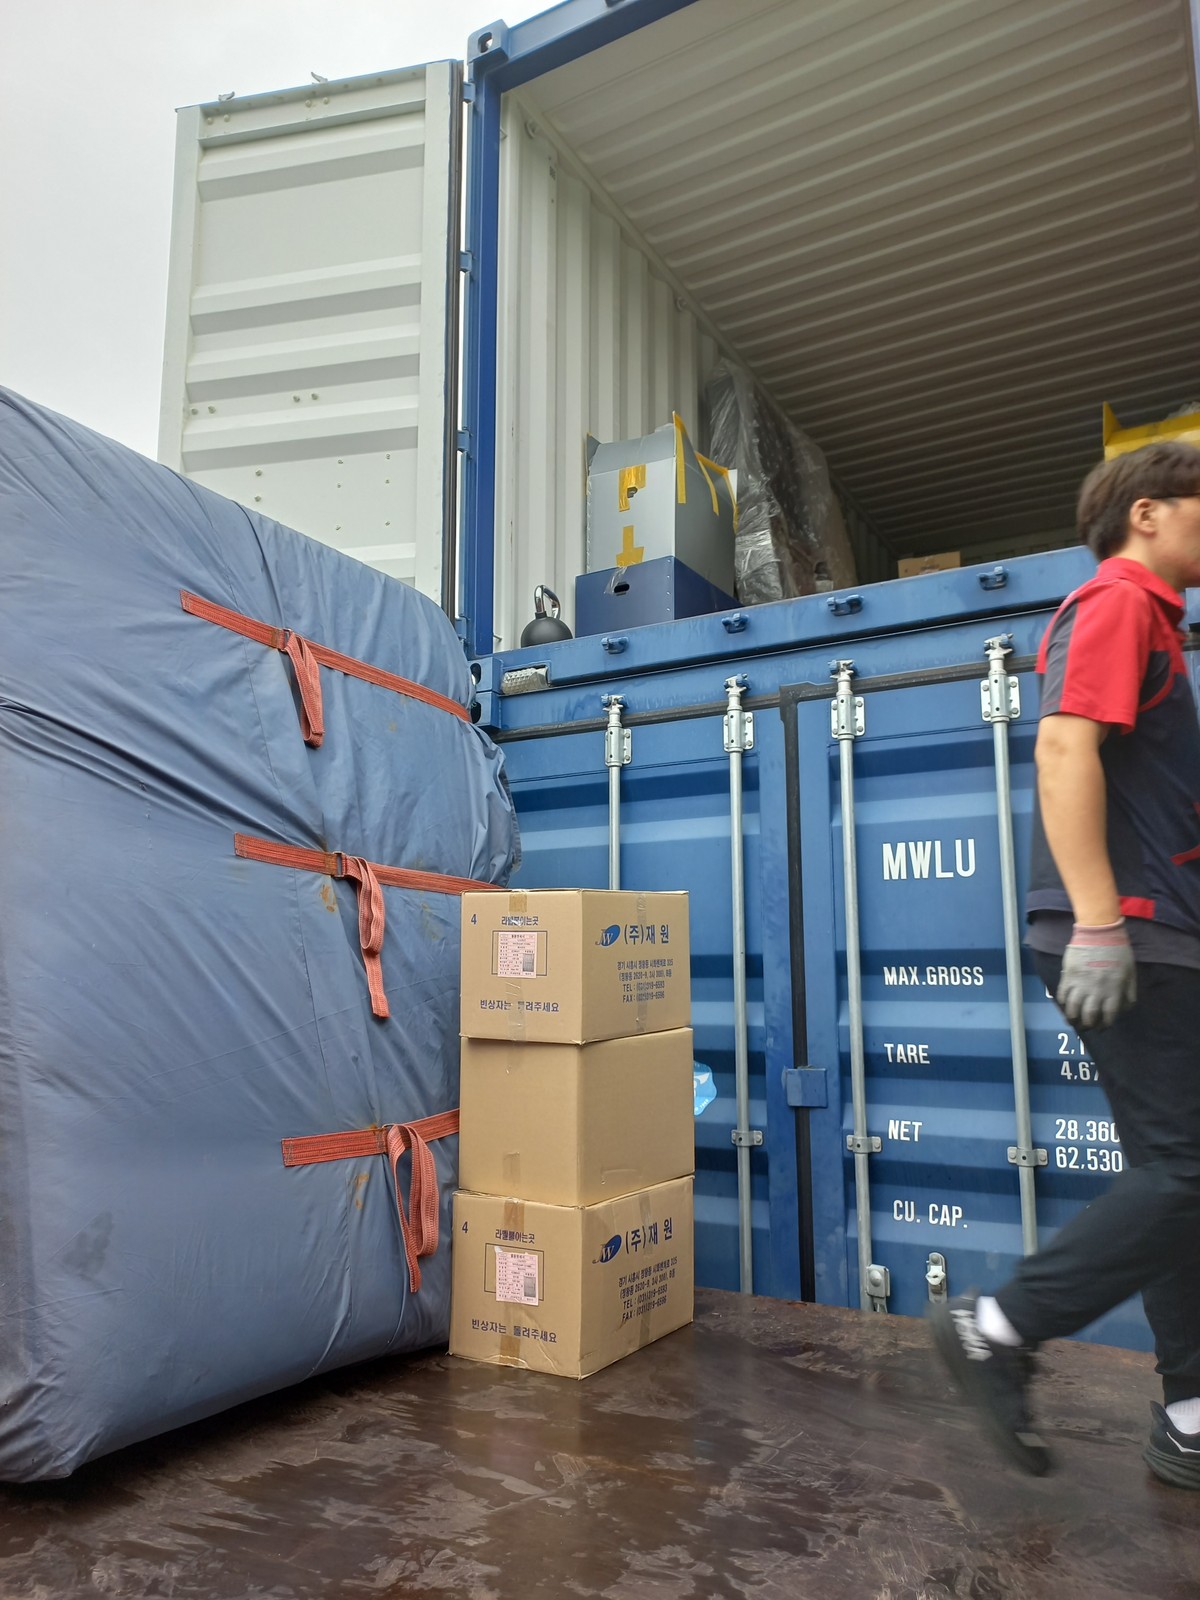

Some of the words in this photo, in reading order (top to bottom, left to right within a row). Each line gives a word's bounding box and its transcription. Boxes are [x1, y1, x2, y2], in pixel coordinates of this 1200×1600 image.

[883, 838, 976, 880] MWLU
[471, 913, 477, 925] 4
[883, 966, 984, 986] MAX.GROSS
[480, 1000, 512, 1010] 빈상자는
[884, 1043, 930, 1064] TARE
[1060, 1061, 1099, 1081] 4,67
[888, 1119, 923, 1142] NET
[1055, 1146, 1124, 1173] 62,530
[893, 1200, 921, 1223] CU.
[928, 1204, 968, 1229] CAP.
[462, 1221, 468, 1234] 4
[471, 1318, 507, 1334] 빈상자는
